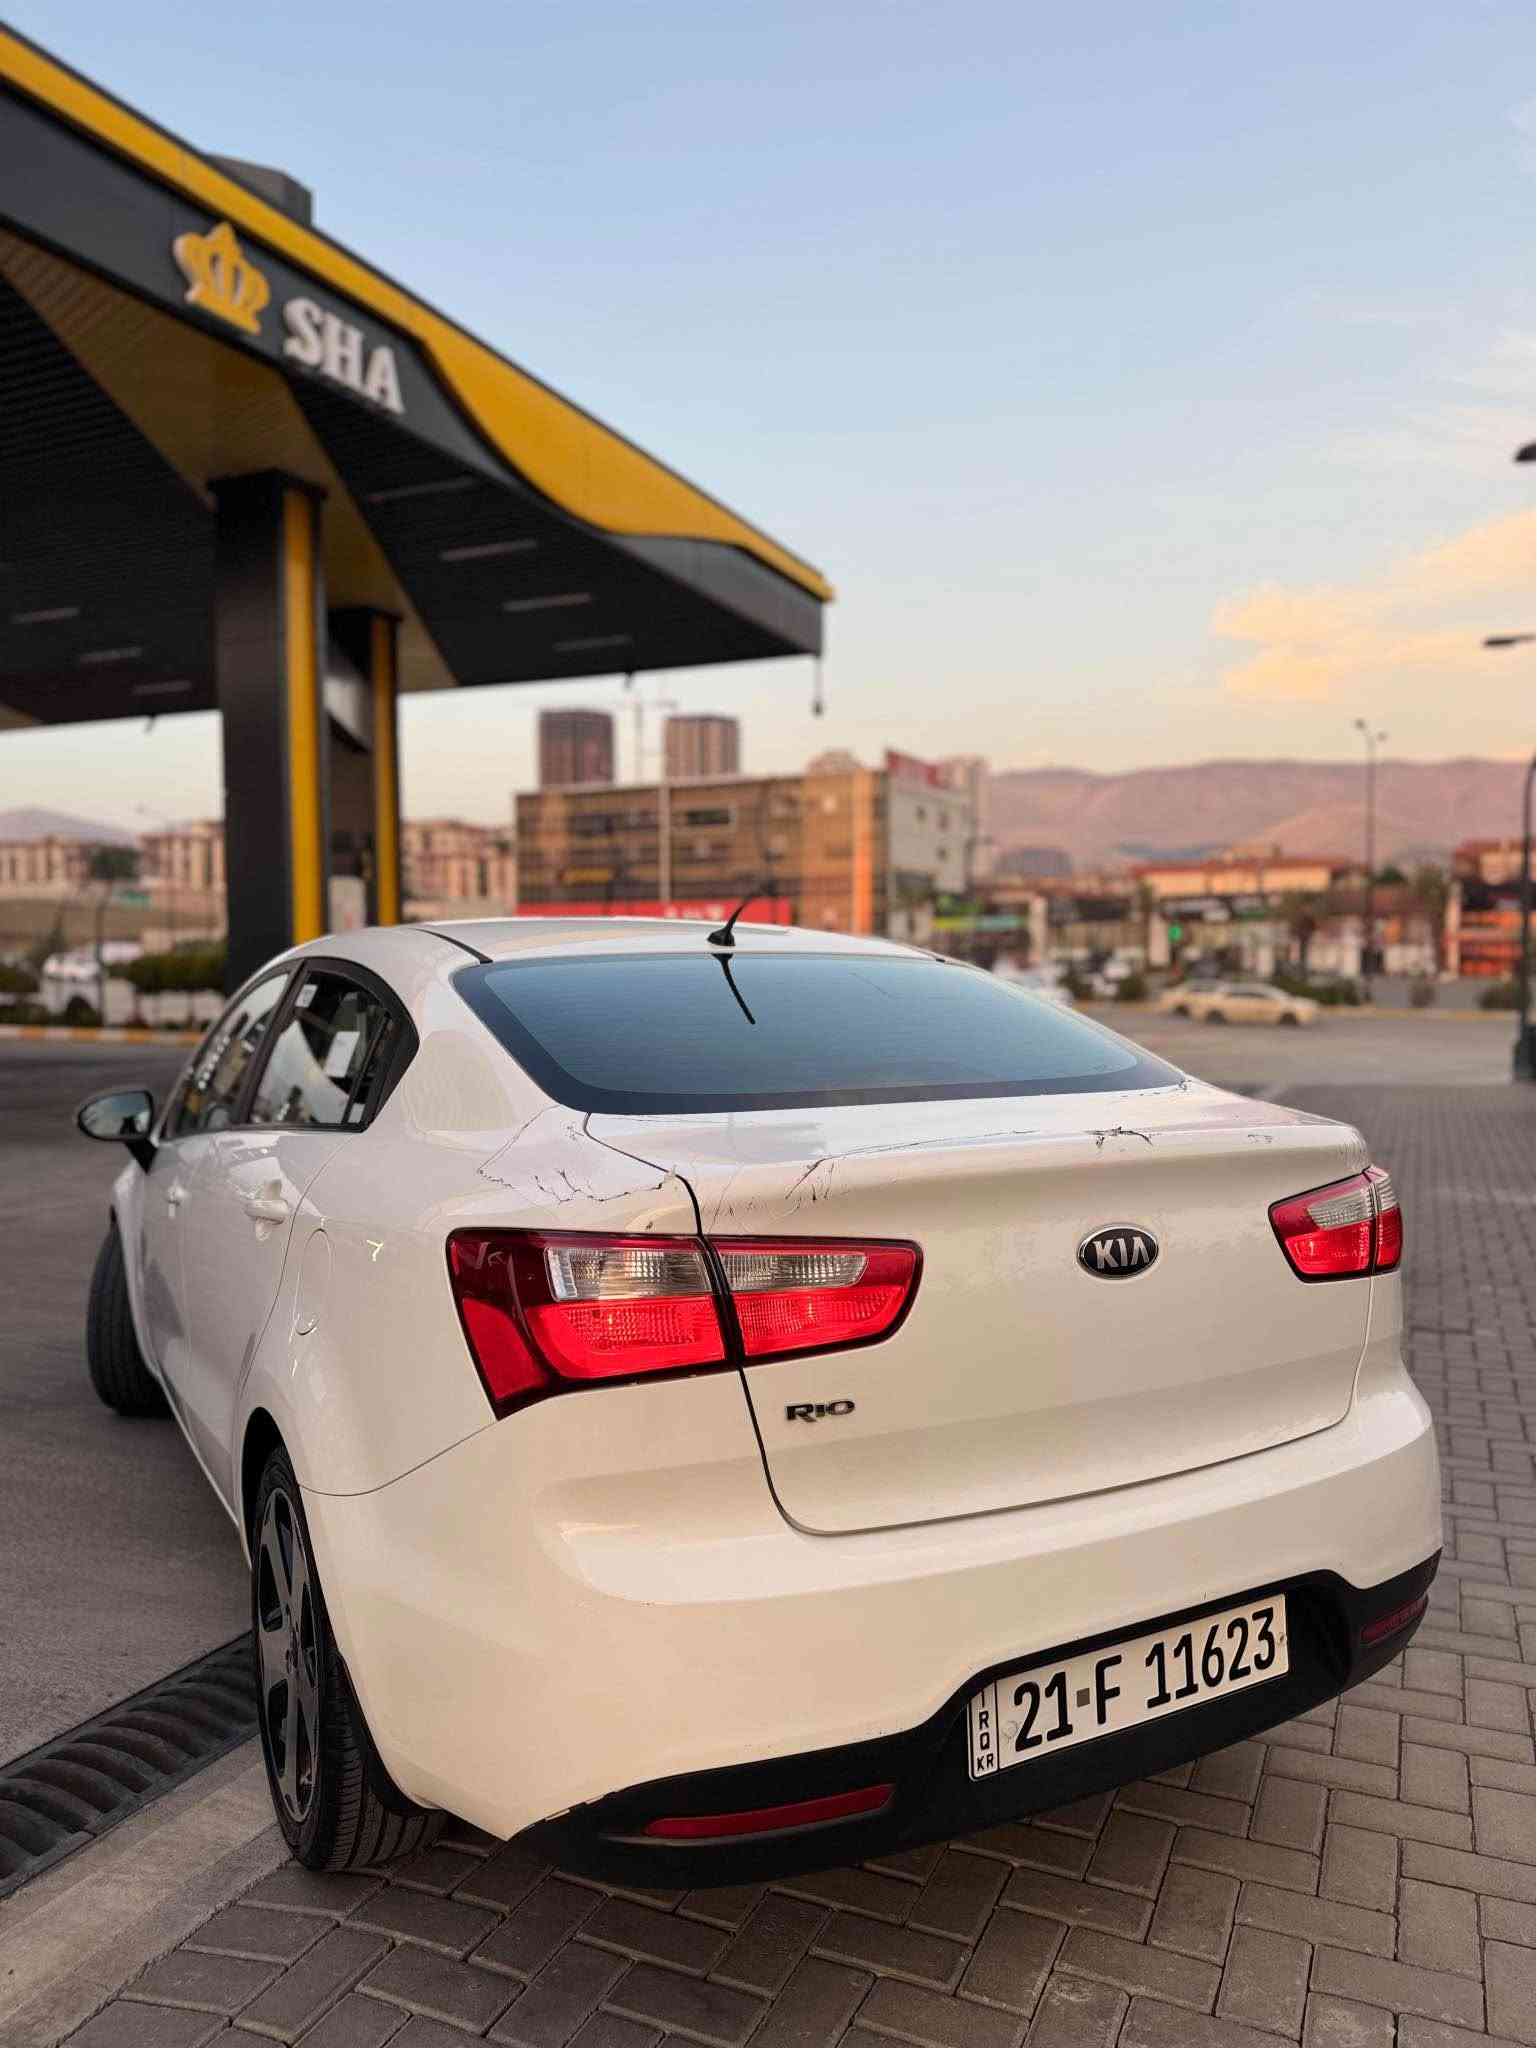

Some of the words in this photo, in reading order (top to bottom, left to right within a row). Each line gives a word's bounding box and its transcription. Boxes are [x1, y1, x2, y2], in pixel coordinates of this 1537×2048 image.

[282, 298, 404, 414] SHA
[1092, 1236, 1150, 1270] KIA
[1145, 1607, 1275, 1708] 11623
